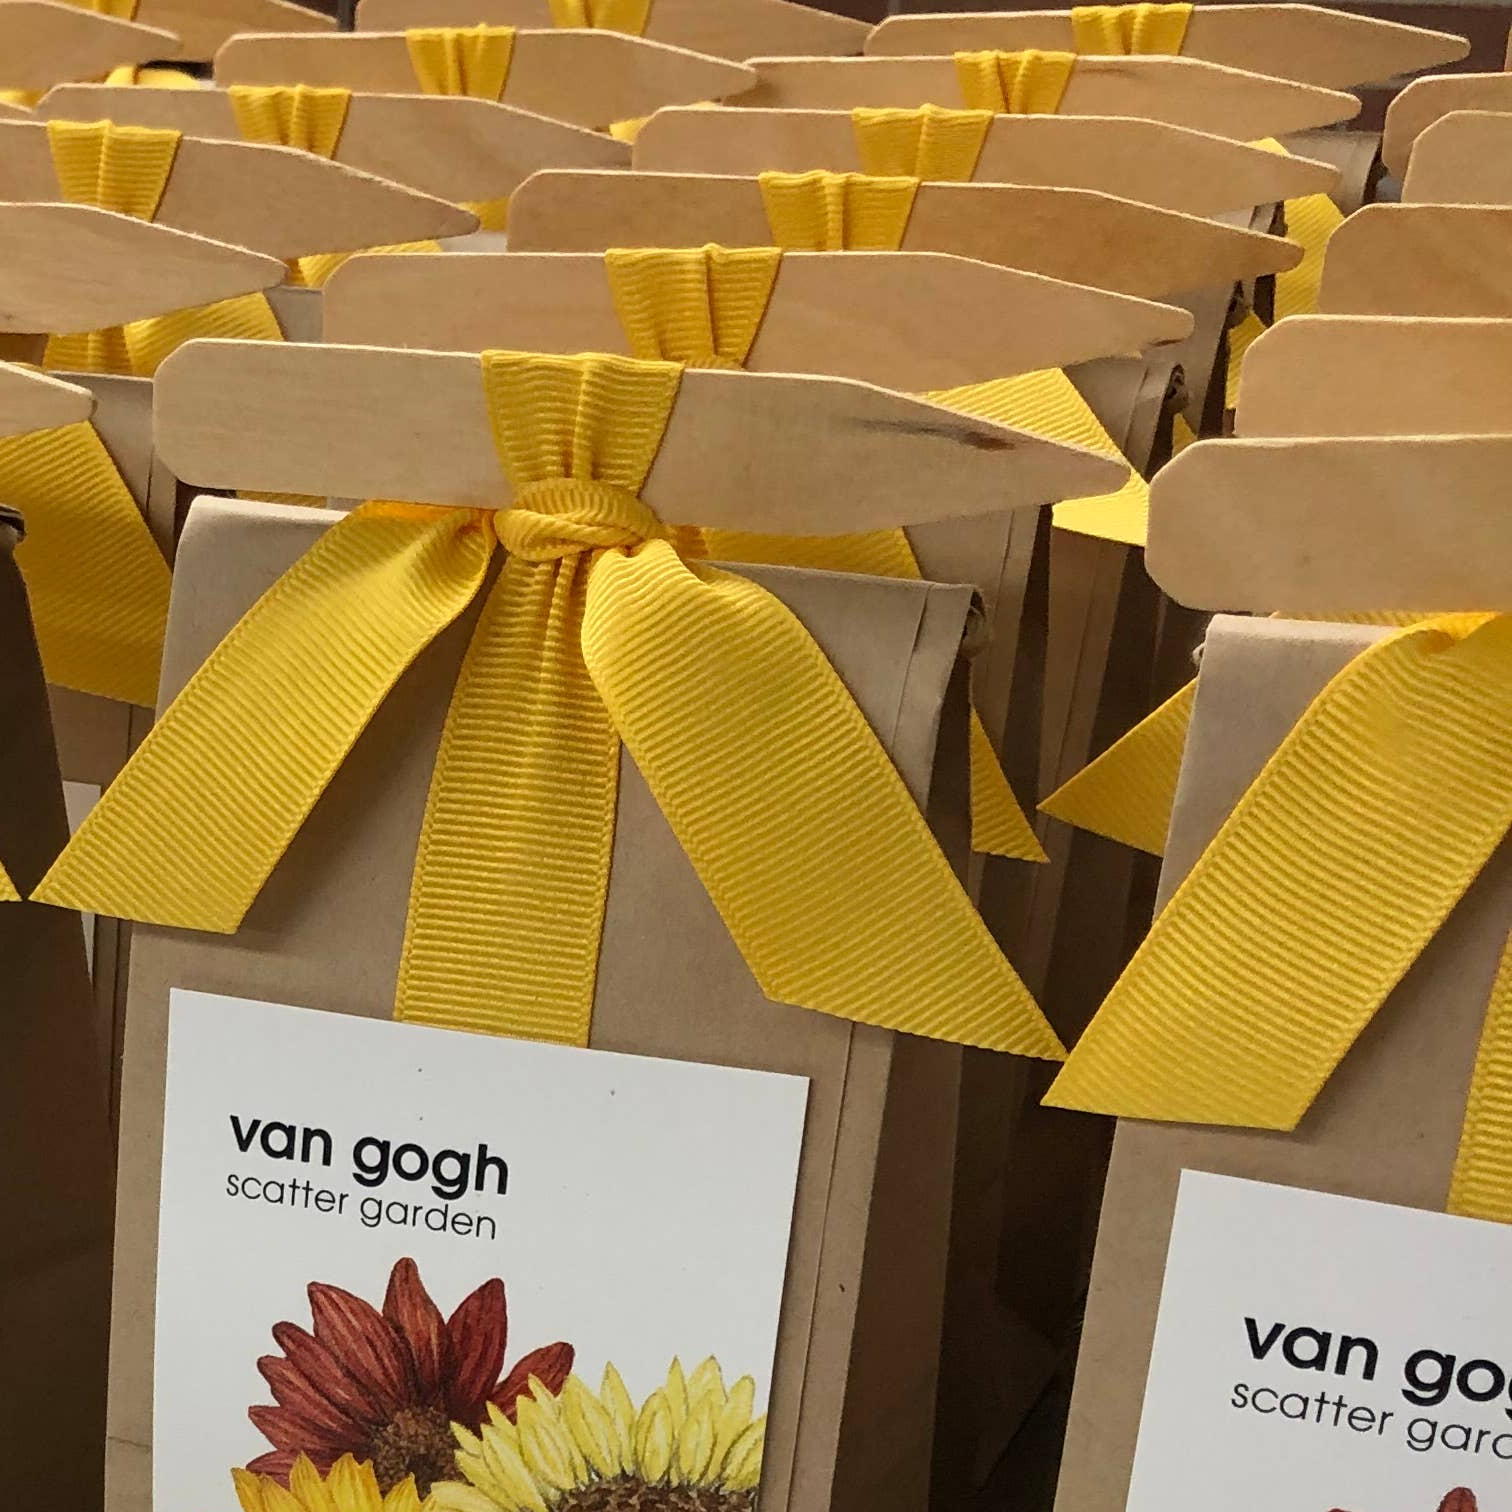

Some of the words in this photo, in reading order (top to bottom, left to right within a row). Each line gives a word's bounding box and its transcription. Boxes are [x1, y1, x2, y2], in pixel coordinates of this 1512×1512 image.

[229, 1114, 333, 1168] van
[352, 1136, 509, 1201] gogh
[225, 1173, 350, 1215] scatter
[359, 1197, 497, 1241] garden
[1244, 1317, 1380, 1382] van
[1400, 1349, 1512, 1421] go
[1230, 1383, 1395, 1436] scatter
